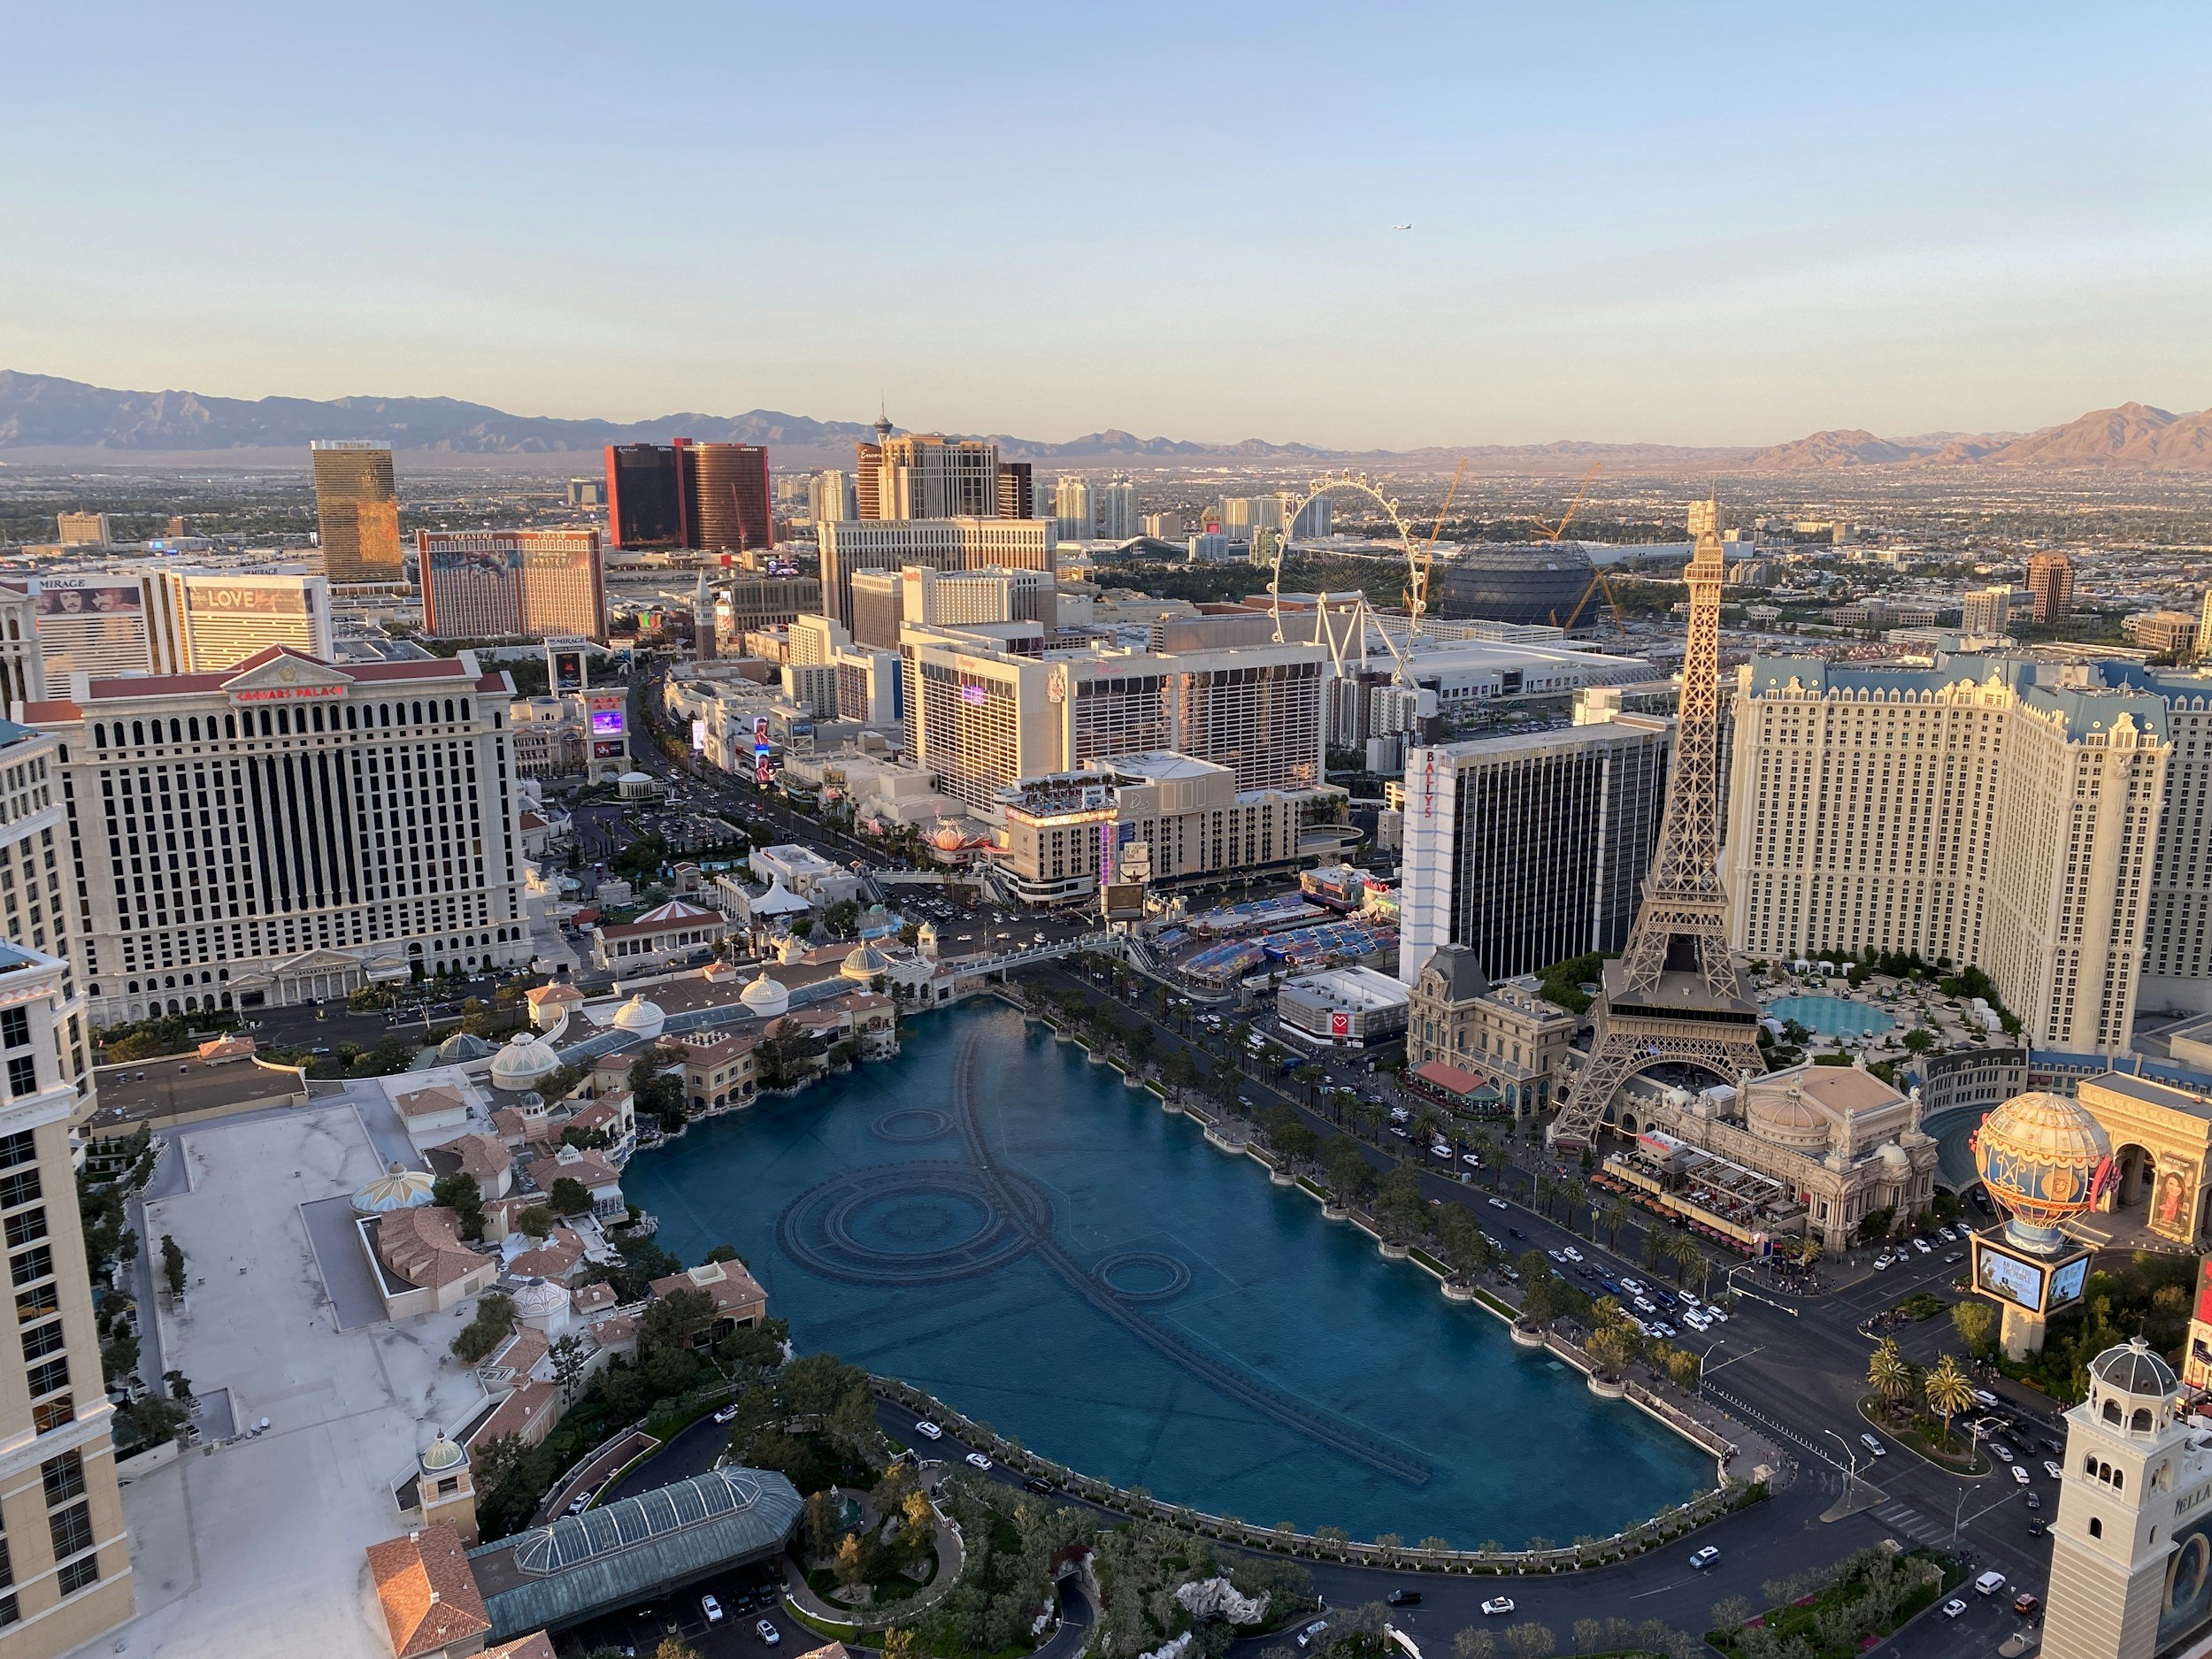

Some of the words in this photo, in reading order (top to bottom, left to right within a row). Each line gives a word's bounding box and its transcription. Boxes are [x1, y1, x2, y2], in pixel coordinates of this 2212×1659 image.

[251, 567, 278, 576] MIRAGE
[40, 579, 85, 588] MIRAGE
[208, 589, 255, 608] LOVE
[235, 688, 292, 702] CAESARS
[296, 685, 344, 697] PALACE
[2174, 1484, 2212, 1518] ELLA
